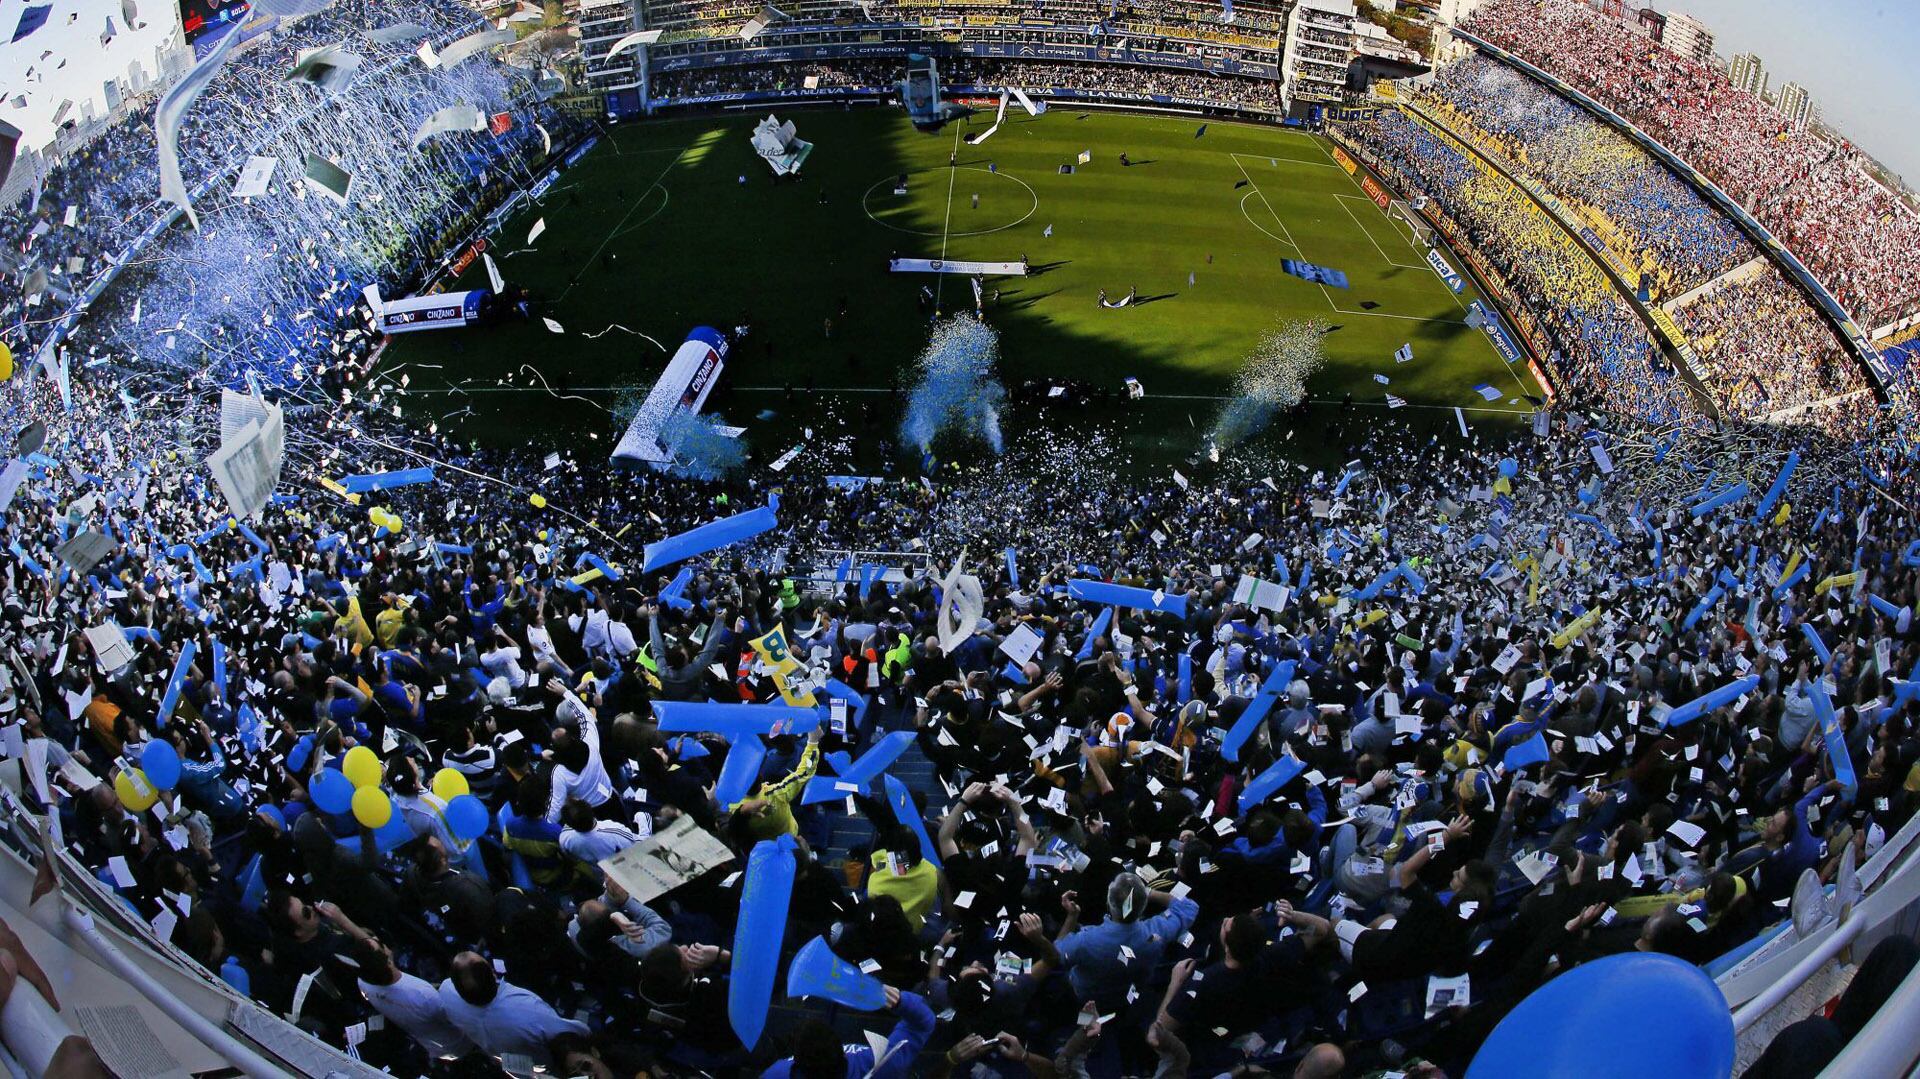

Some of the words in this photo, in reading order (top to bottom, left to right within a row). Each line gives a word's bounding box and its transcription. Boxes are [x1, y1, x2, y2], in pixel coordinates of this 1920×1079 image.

[1510, 188, 1533, 209] BOCA
[1534, 208, 1569, 241] JUNIORS
[1428, 252, 1450, 276] sica
[426, 308, 455, 319] CINZANO
[1493, 331, 1515, 359] Seguros
[691, 358, 714, 392] CINZANO
